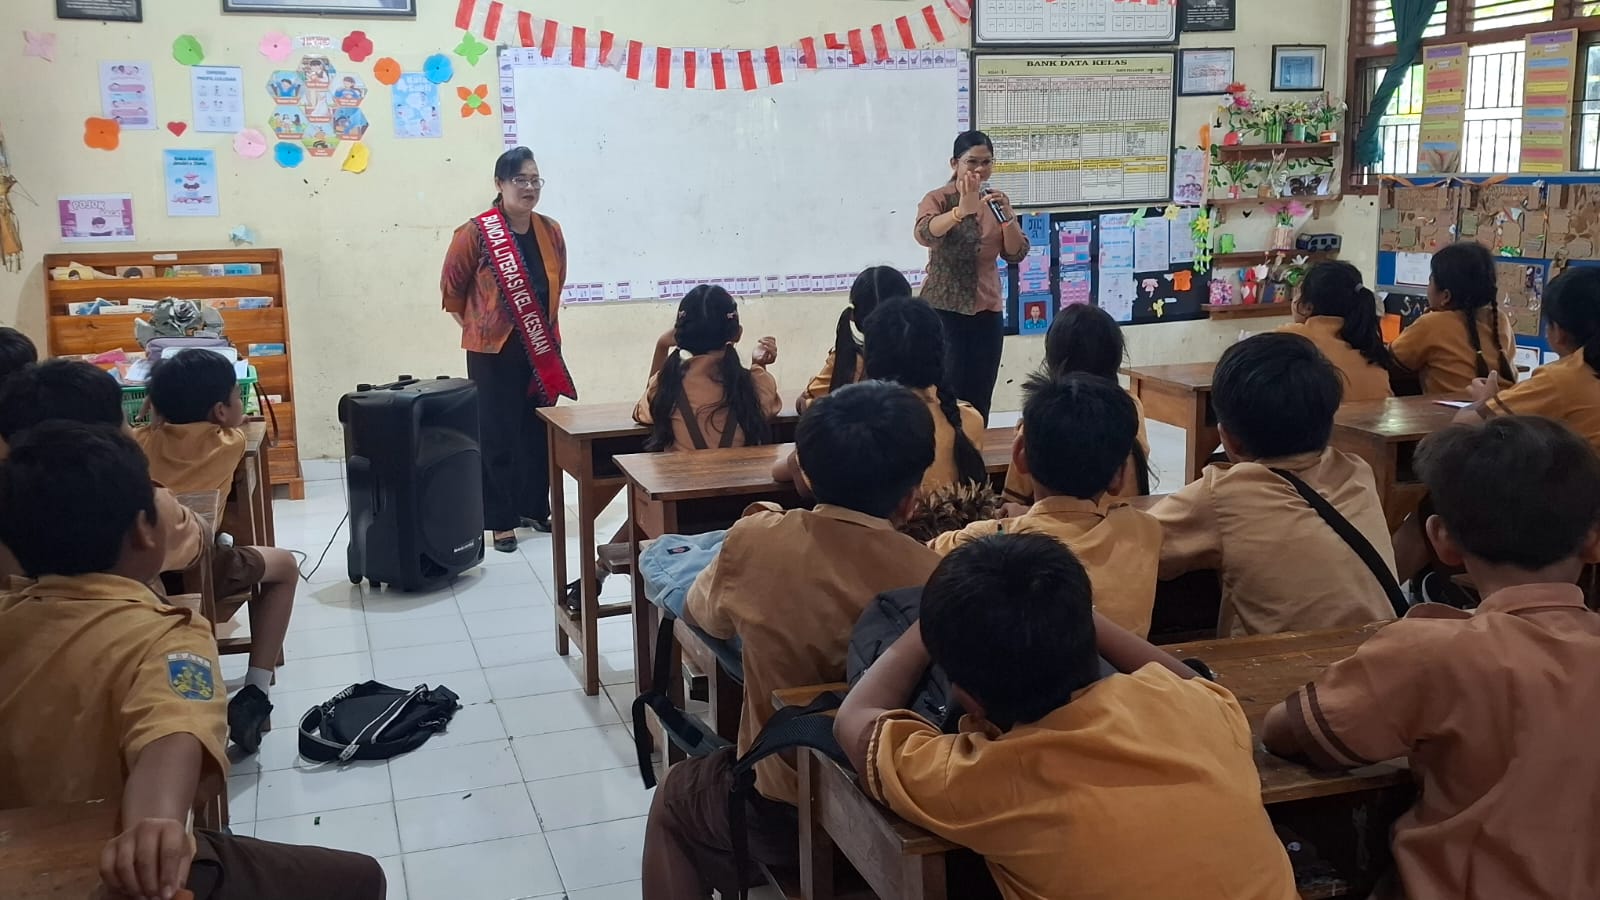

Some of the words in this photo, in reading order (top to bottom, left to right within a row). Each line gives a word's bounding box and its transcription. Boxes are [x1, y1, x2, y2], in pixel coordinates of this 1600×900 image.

[71, 200, 106, 211] POJOK
[481, 214, 508, 248] BUNDA
[493, 246, 526, 292] LITERASI
[521, 310, 552, 356] KESIMAN
